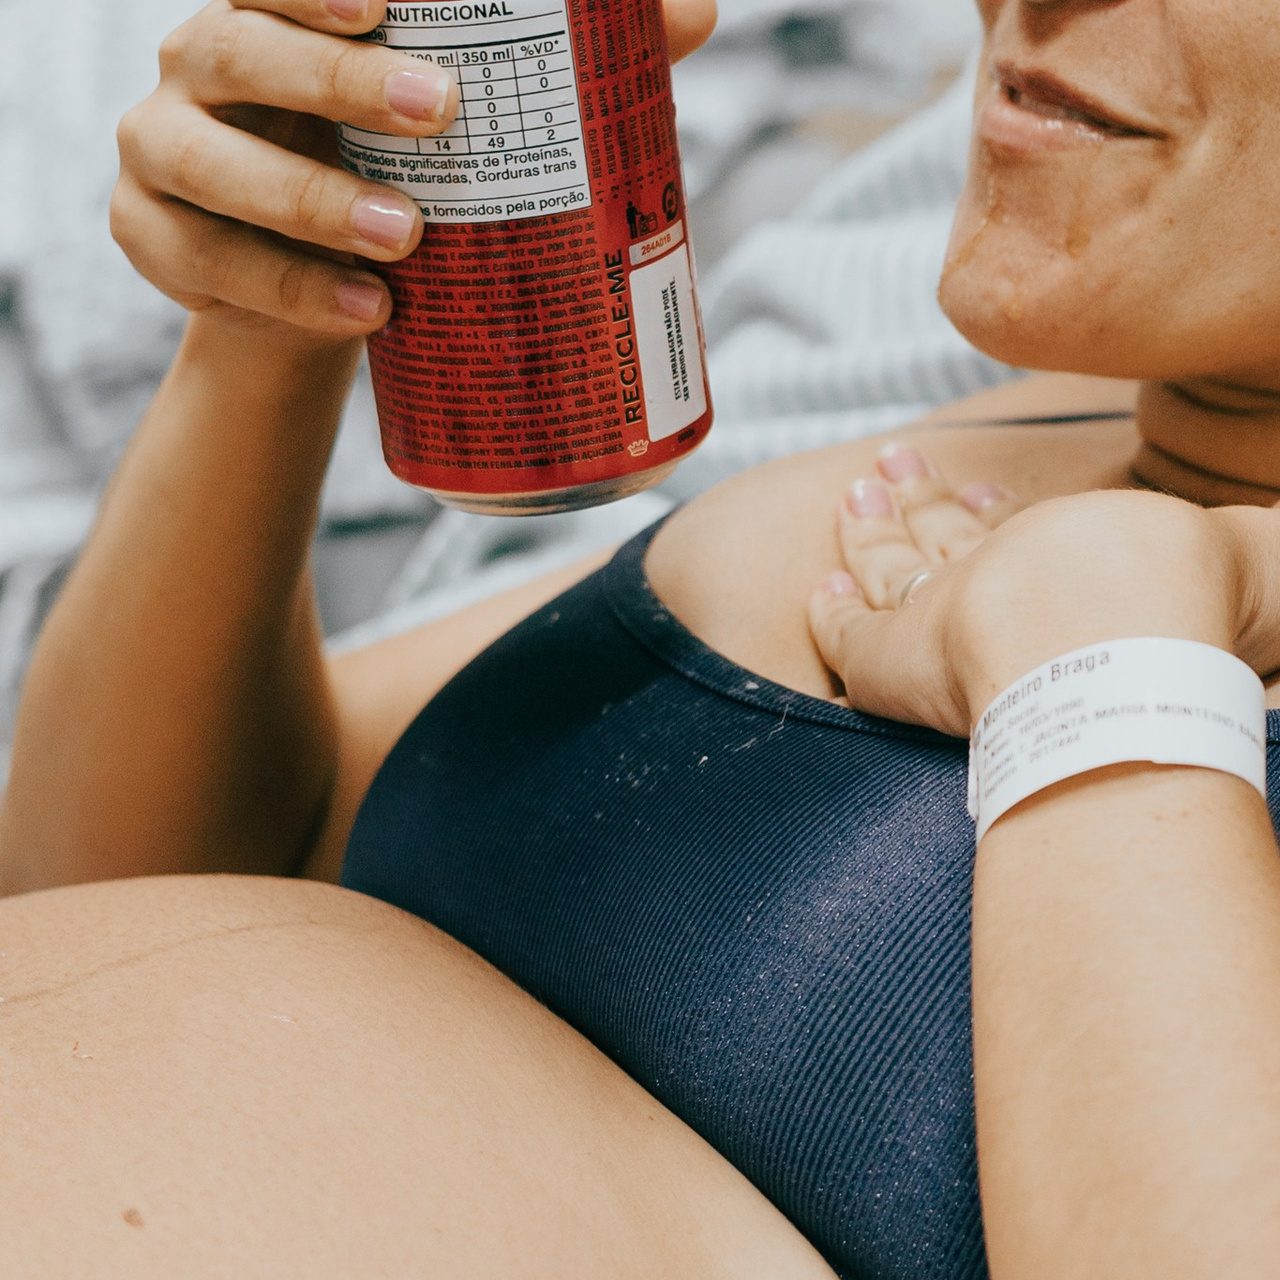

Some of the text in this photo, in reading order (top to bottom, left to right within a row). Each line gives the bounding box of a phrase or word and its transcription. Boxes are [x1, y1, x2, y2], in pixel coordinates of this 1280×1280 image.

[386, 1, 514, 22] NUTRICIONAL
[437, 53, 454, 65] ml
[461, 52, 488, 64] 350
[492, 48, 510, 61] ml
[482, 60, 546, 79] 0 0
[484, 77, 549, 96] 0 0
[487, 102, 496, 114] 0
[490, 112, 553, 132] 0 0
[434, 129, 556, 152] 14 49 2
[362, 164, 405, 182] Gorduras
[407, 170, 472, 184] saturadas,
[476, 164, 540, 183] Gorduras
[543, 158, 577, 175] trans
[399, 155, 479, 172] significativas
[482, 155, 500, 168] de
[504, 146, 572, 166] Proteínas,
[434, 204, 502, 218] fornecidos
[506, 199, 536, 216] pela
[539, 191, 588, 211] porção.
[606, 250, 643, 426] RECICLE-ME
[662, 287, 682, 401] ESTA EMBALAGEM NÃO PODE
[677, 348, 688, 384] VENDIDA
[983, 651, 1110, 731] Monteiro Braga
